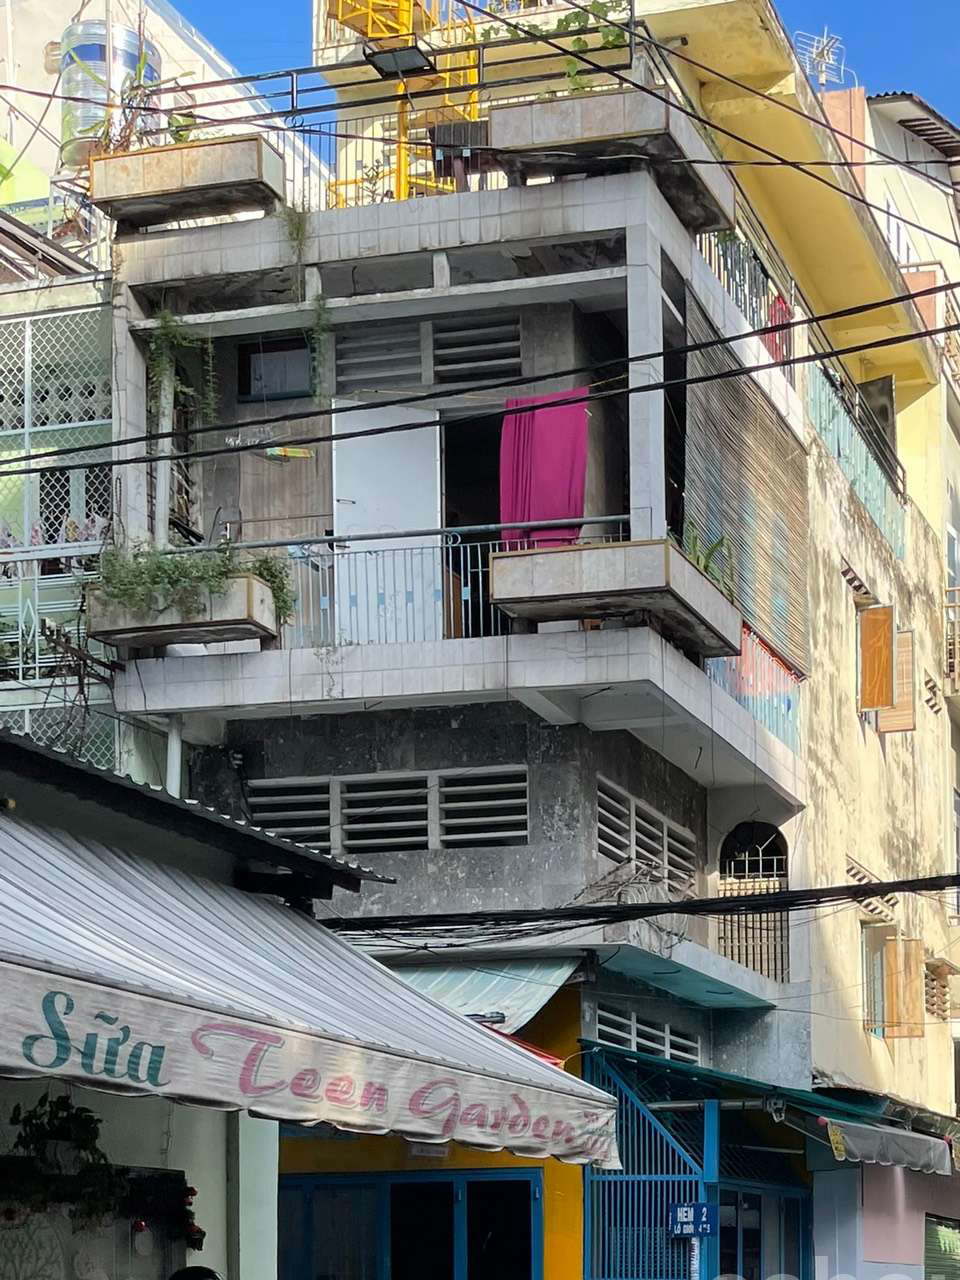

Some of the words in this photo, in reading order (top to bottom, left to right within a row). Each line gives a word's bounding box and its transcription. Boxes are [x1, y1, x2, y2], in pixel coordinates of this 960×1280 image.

[22, 991, 171, 1087] Sữa
[191, 1023, 390, 1115] Teen
[408, 1077, 577, 1144] Garden
[701, 1207, 708, 1221] 2
